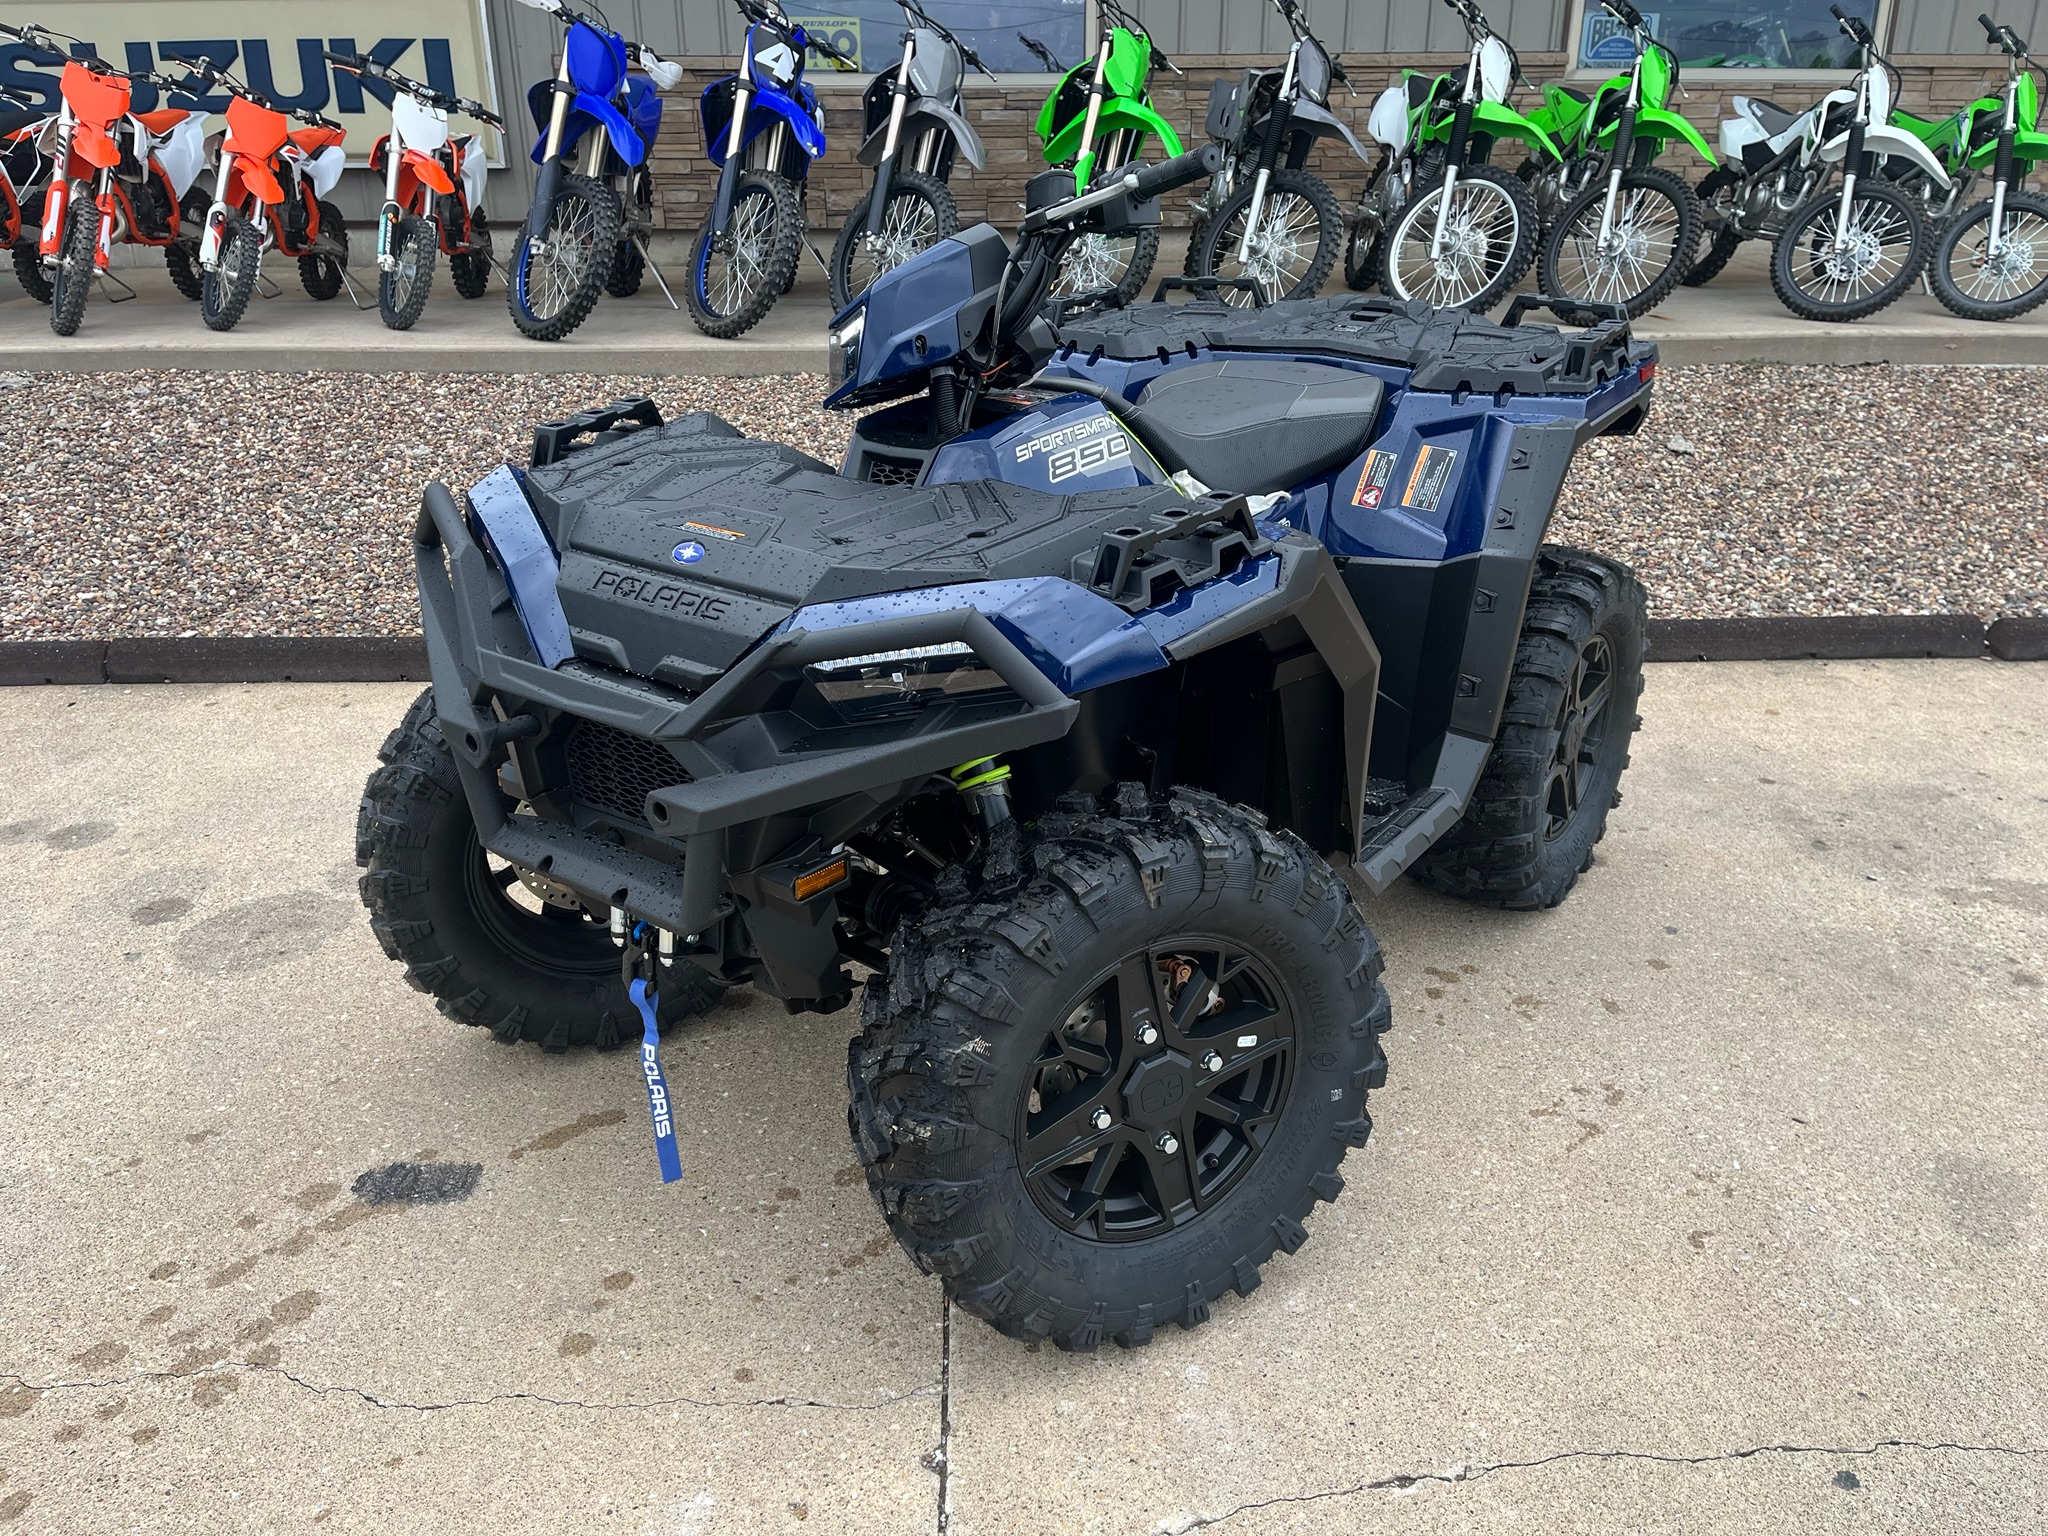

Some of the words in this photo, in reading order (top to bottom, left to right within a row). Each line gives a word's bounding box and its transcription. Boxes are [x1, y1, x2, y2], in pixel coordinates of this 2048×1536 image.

[0, 38, 459, 115] SUZUKI
[1015, 415, 1119, 463] SPORTSMAN
[1048, 432, 1131, 484] 850
[591, 570, 732, 622] POLARIS
[643, 1042, 671, 1139] POLARIS
